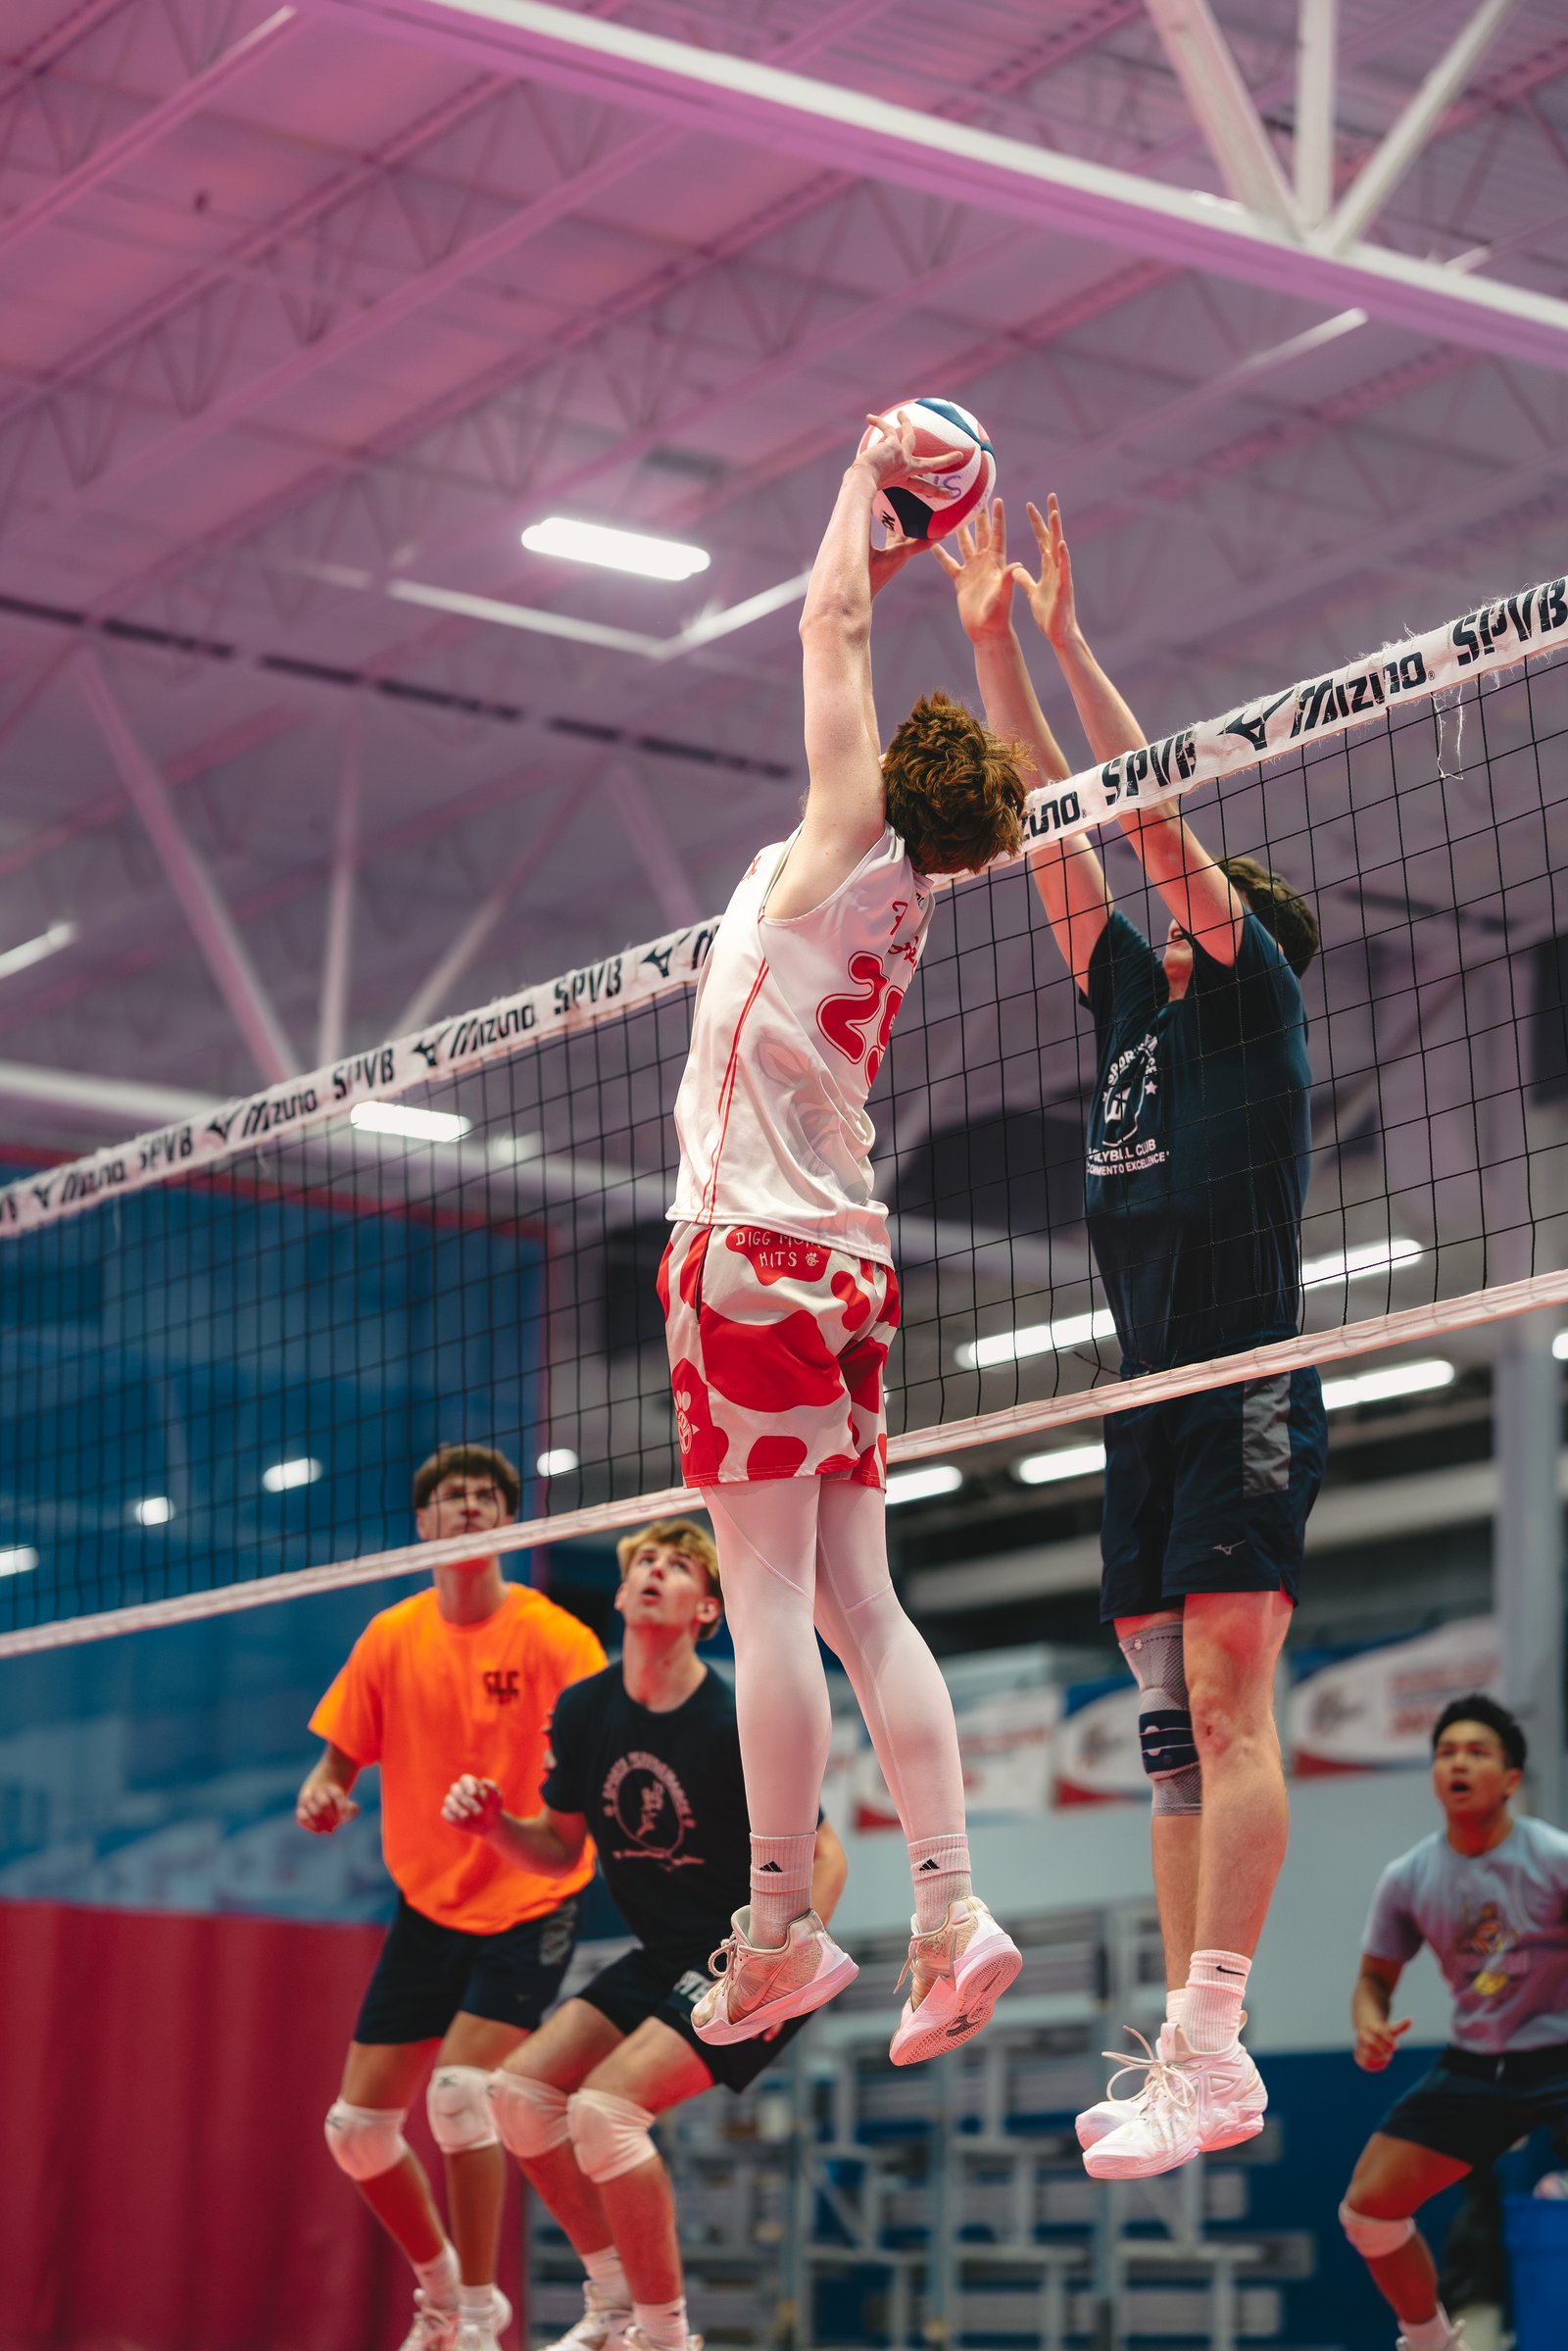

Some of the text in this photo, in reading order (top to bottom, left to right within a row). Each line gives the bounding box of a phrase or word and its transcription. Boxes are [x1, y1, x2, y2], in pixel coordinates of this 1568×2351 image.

[1102, 730, 1198, 806] SPVB
[1451, 577, 1568, 666] SPVB
[554, 956, 622, 1015] SPVB
[1135, 1139, 1156, 1156] CLUB
[735, 1231, 771, 1247] DIGG
[759, 1251, 798, 1268] HITS
